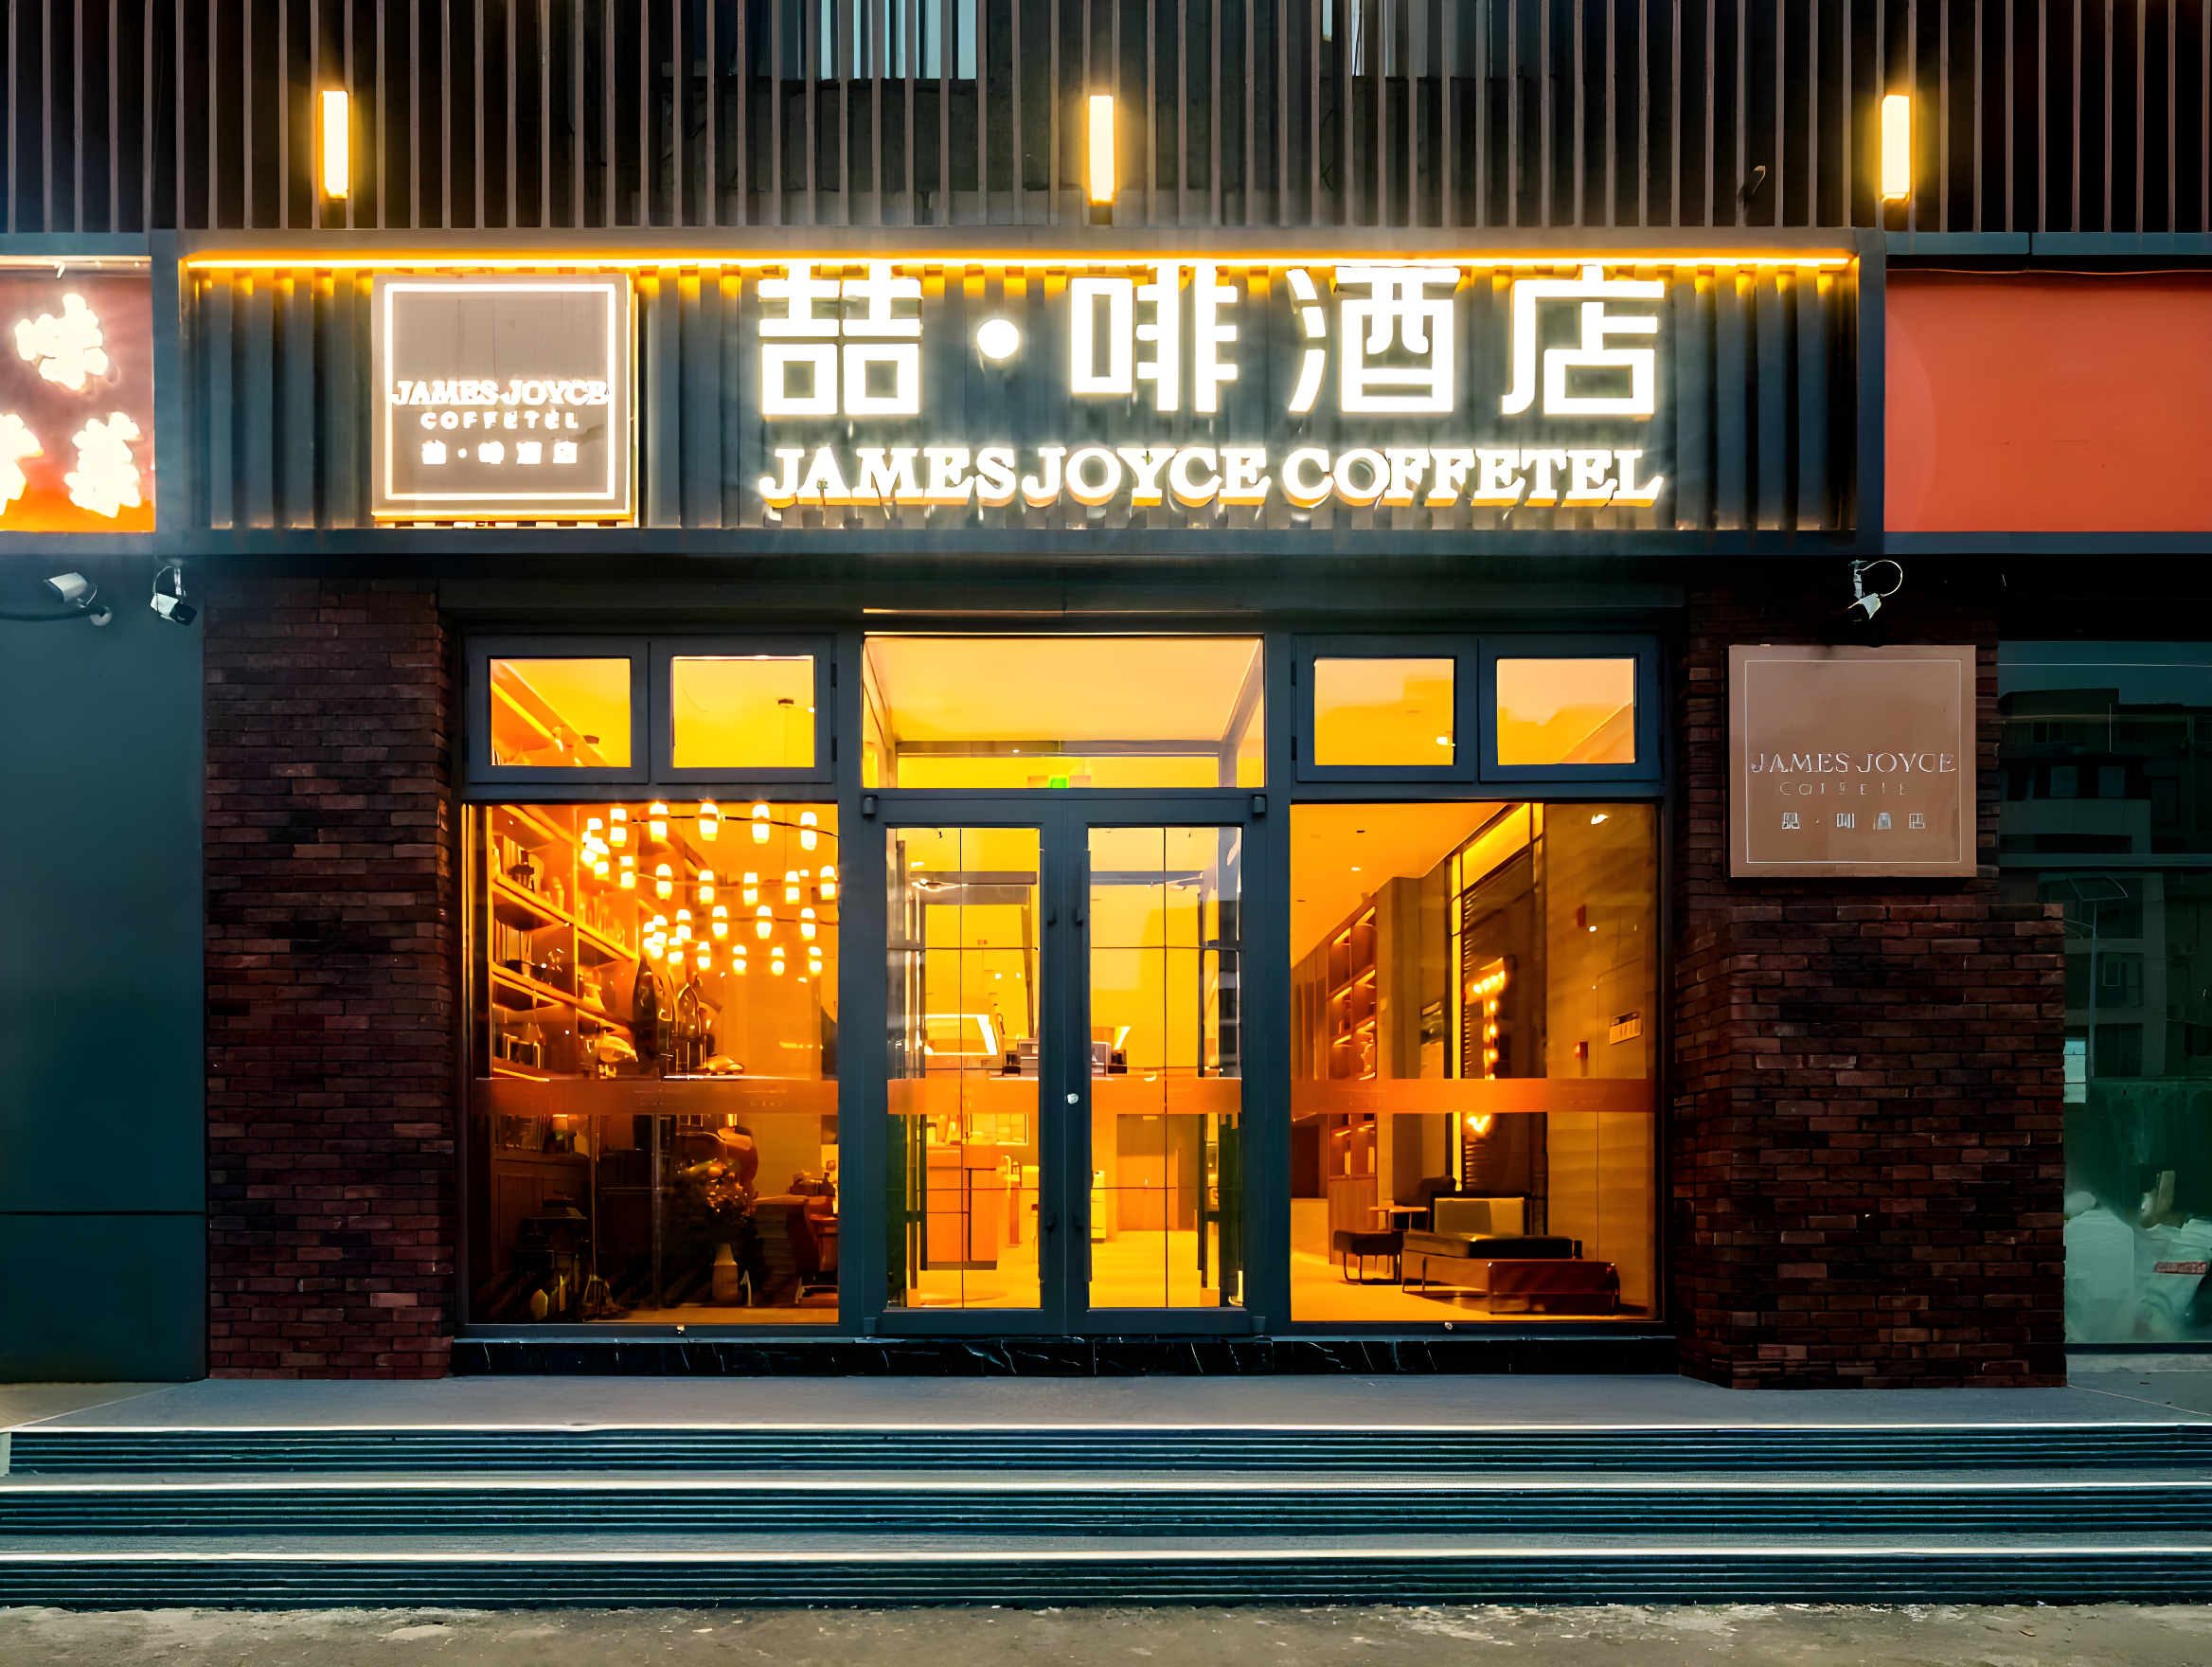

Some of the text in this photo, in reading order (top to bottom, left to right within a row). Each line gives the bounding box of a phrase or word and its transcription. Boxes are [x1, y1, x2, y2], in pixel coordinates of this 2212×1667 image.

[758, 265, 1665, 415] 喆·啡酒店
[391, 381, 609, 405] JAMES JOYCE
[420, 411, 579, 429] COFFETEL
[758, 445, 1664, 508] JAMES JOYCE COFFETEL
[1751, 753, 1955, 773] JAMES JOYCE
